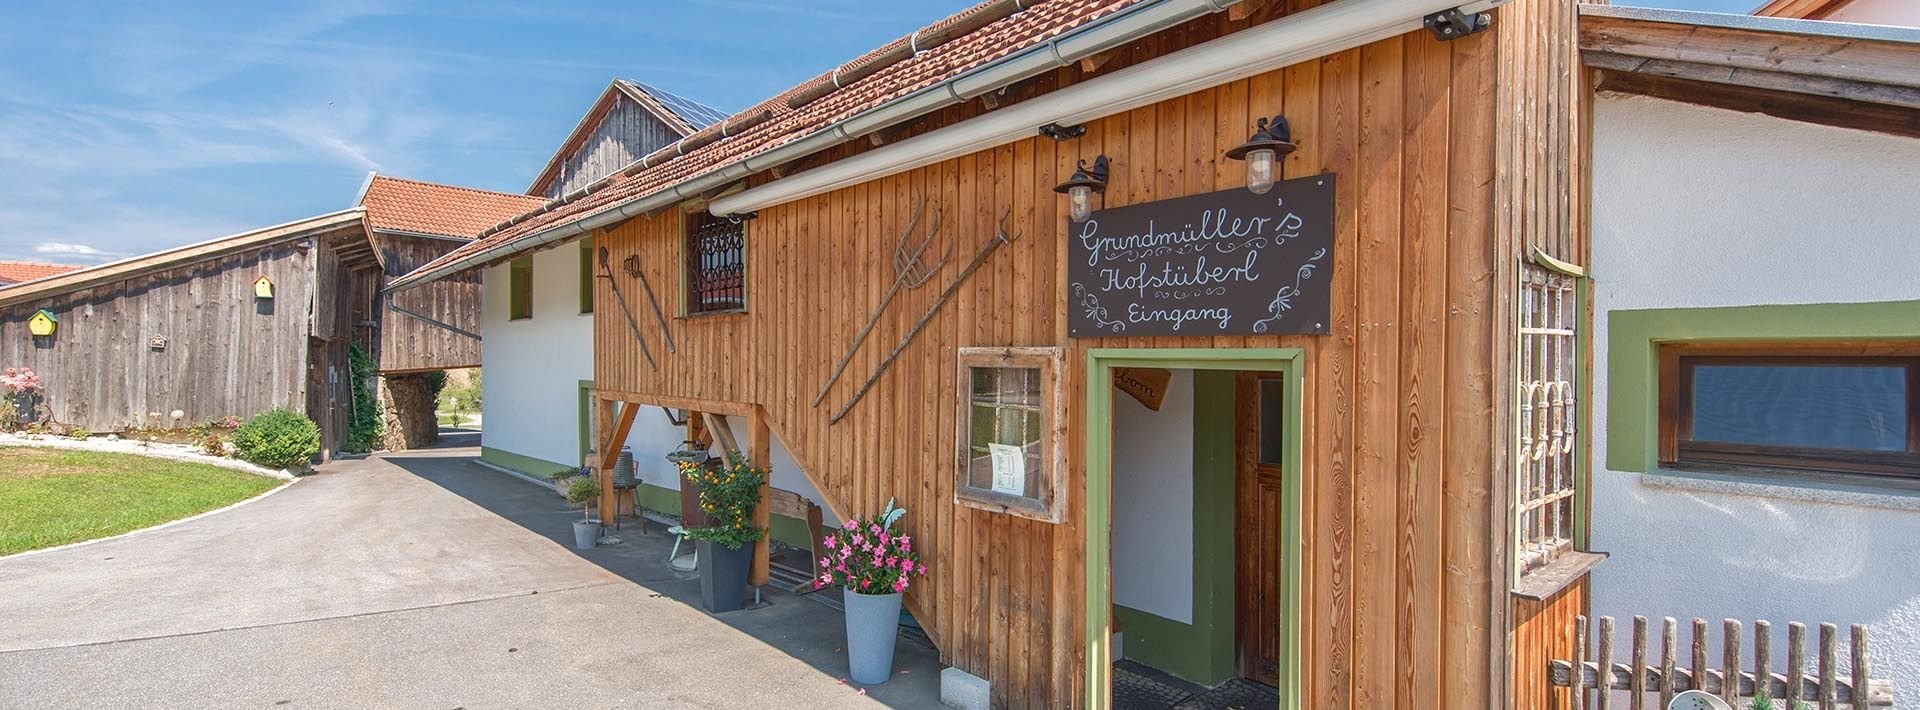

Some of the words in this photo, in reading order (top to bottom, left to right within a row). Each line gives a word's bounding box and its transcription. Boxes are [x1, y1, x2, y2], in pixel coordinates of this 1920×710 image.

[1080, 197, 1303, 266] Grundmüller's
[1099, 250, 1260, 298] Hofstüberl
[1128, 303, 1232, 330] Eingang
